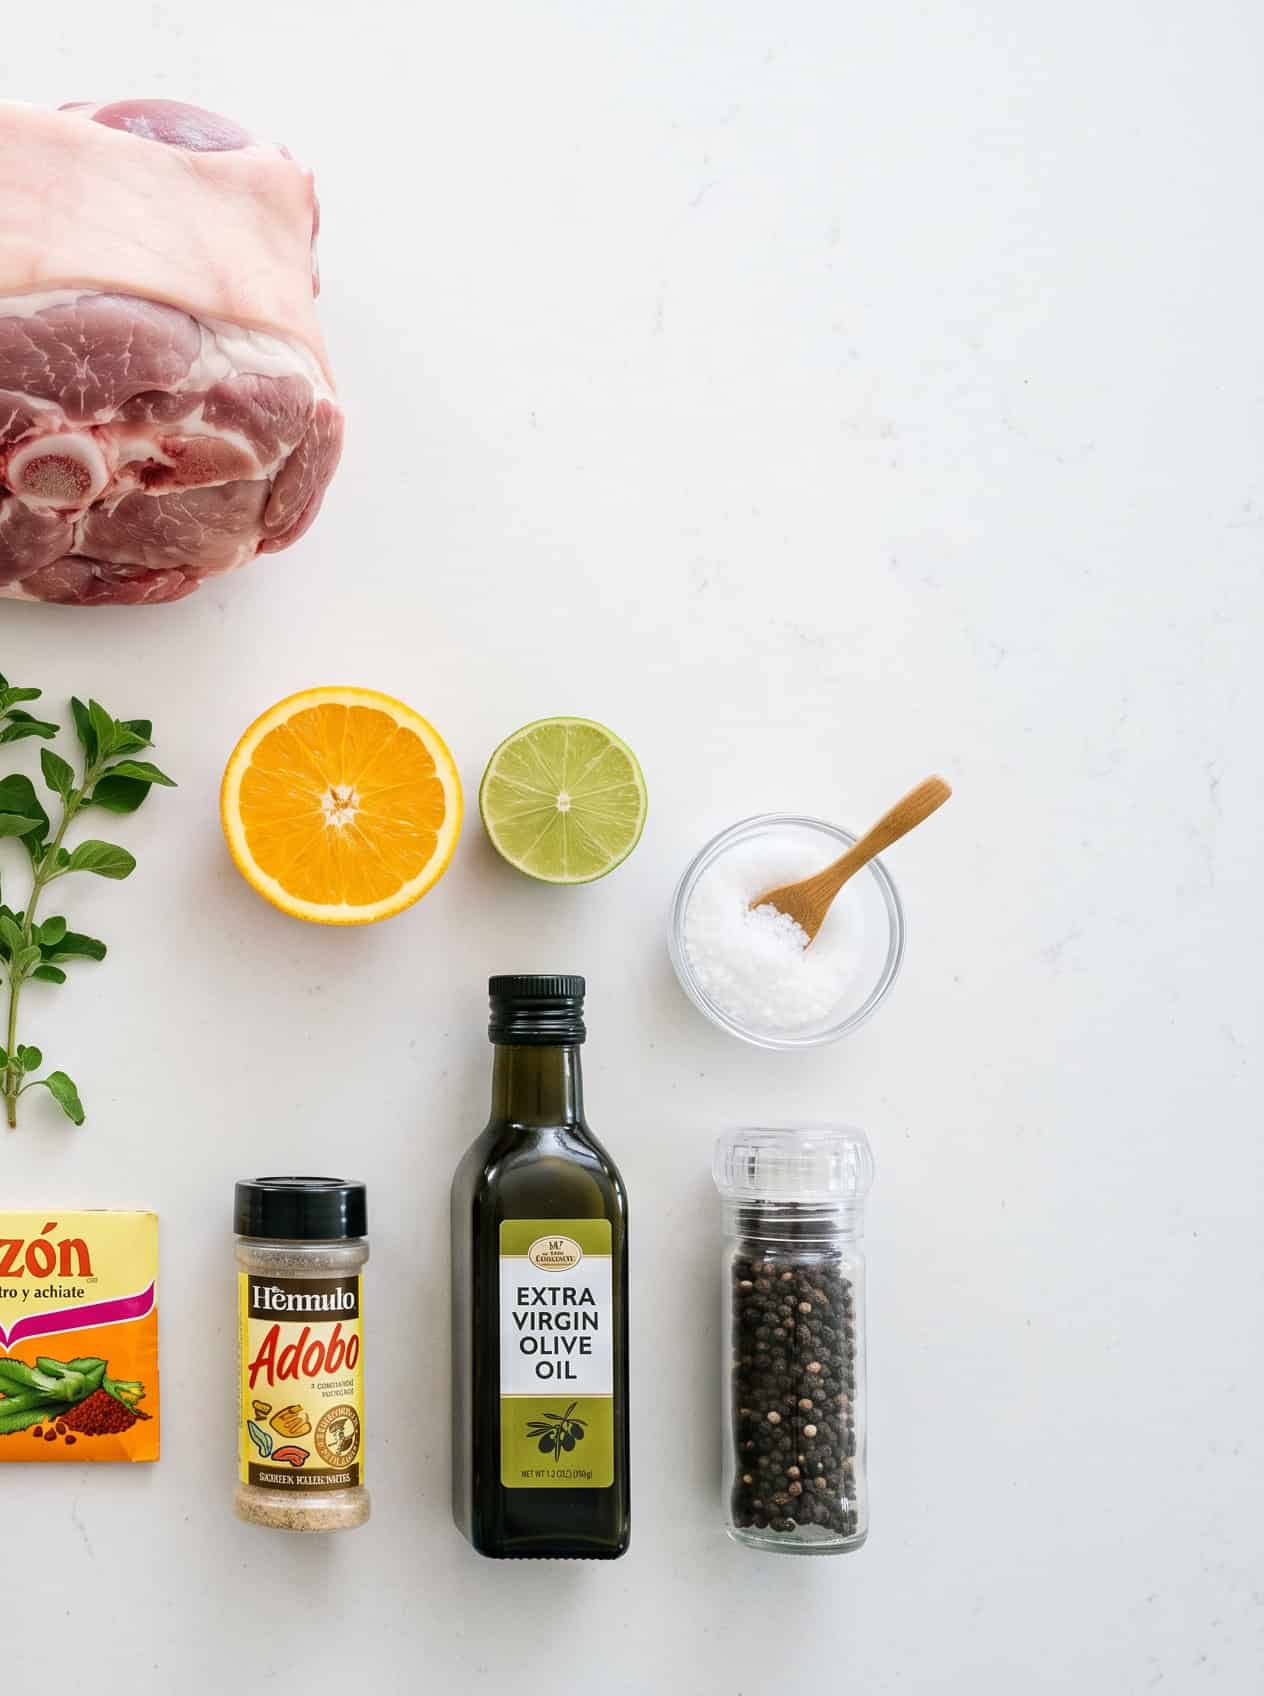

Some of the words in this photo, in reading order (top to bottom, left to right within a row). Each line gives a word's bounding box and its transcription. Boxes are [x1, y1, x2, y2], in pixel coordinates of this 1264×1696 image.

[21, 1288, 30, 1302] y
[34, 1285, 85, 1299] achiate
[517, 1287, 596, 1306] EXTRA
[512, 1311, 599, 1331] VIRGIN
[519, 1335, 593, 1355] OLIVE
[248, 1322, 360, 1390] Adobo
[535, 1360, 577, 1379] OIL
